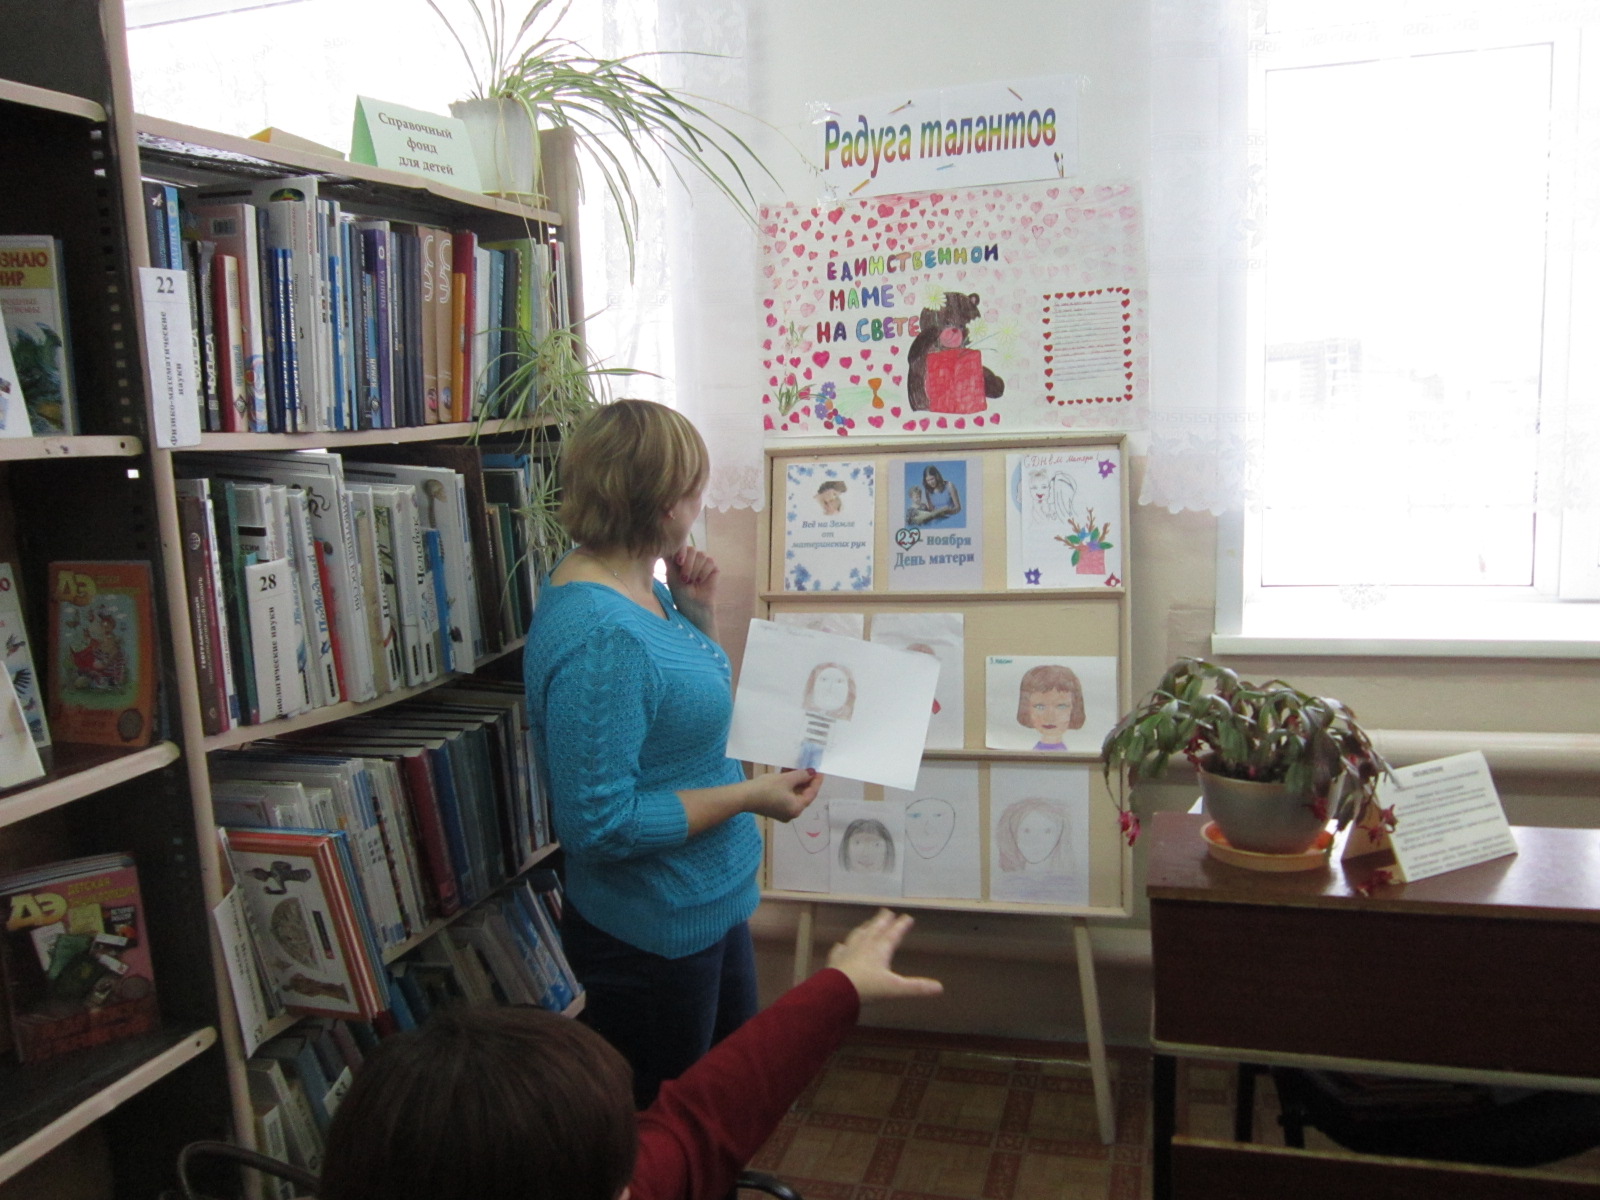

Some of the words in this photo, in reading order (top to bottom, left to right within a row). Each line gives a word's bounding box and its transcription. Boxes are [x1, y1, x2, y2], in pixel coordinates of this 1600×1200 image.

[378, 112, 453, 140] Справочный
[406, 137, 438, 153] фонд
[824, 115, 911, 178] Радуга
[919, 107, 1056, 158] талантов
[398, 156, 420, 169] для
[423, 161, 454, 176] детей
[156, 276, 175, 294] 22
[829, 284, 894, 312] МАМЕ
[816, 321, 847, 344] НА
[856, 315, 921, 343] СВЕТЕ
[159, 311, 178, 446] Физико-математические
[176, 362, 185, 395] науки
[412, 516, 425, 585] Человек
[850, 541, 866, 549] рук
[926, 533, 972, 549] ноября
[894, 552, 926, 570] День
[929, 553, 975, 566] матери
[259, 574, 277, 592] 28
[268, 606, 278, 638] науки
